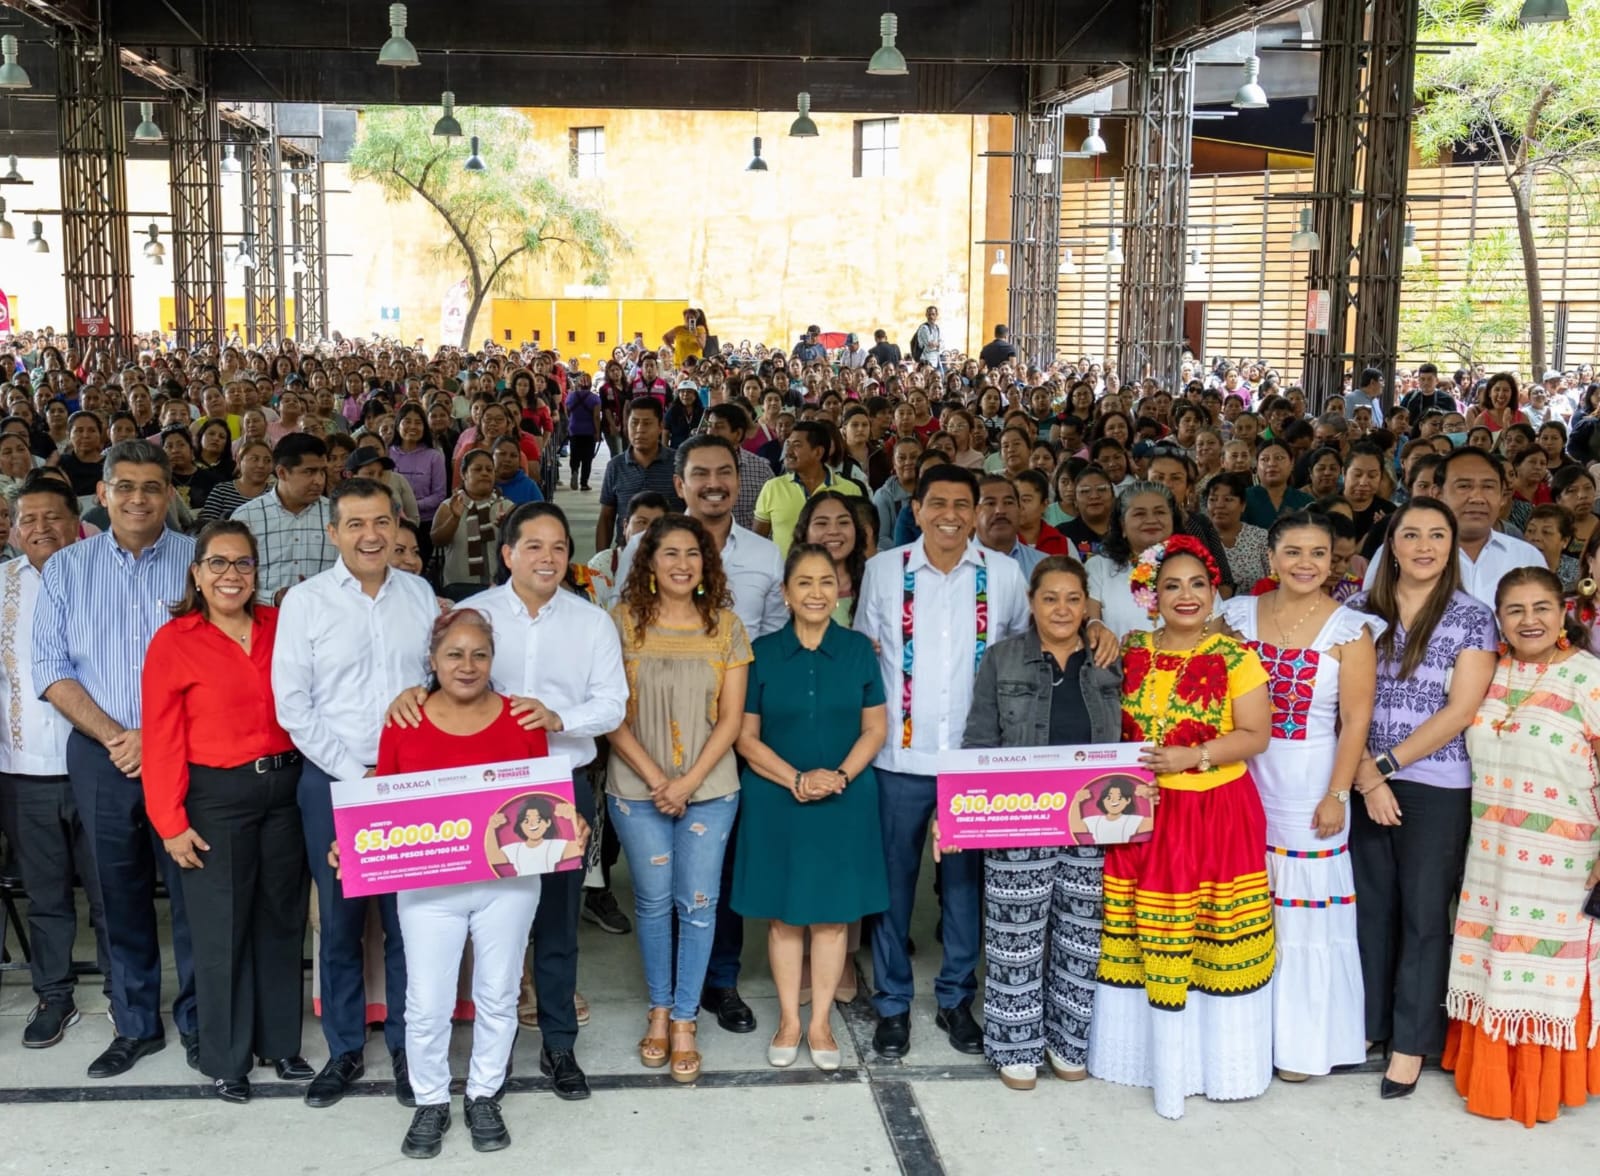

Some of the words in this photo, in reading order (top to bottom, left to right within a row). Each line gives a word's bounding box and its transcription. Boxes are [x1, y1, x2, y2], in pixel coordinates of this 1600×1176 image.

[992, 755, 1027, 764] OAXACA
[392, 780, 431, 792] OAXACA
[951, 792, 1067, 815] $10,000.00
[355, 819, 472, 853] $5,000.00
[360, 854, 386, 864] (CINCO
[387, 853, 399, 861] MIL
[400, 850, 424, 860] PESOS
[424, 848, 450, 857] 00/100
